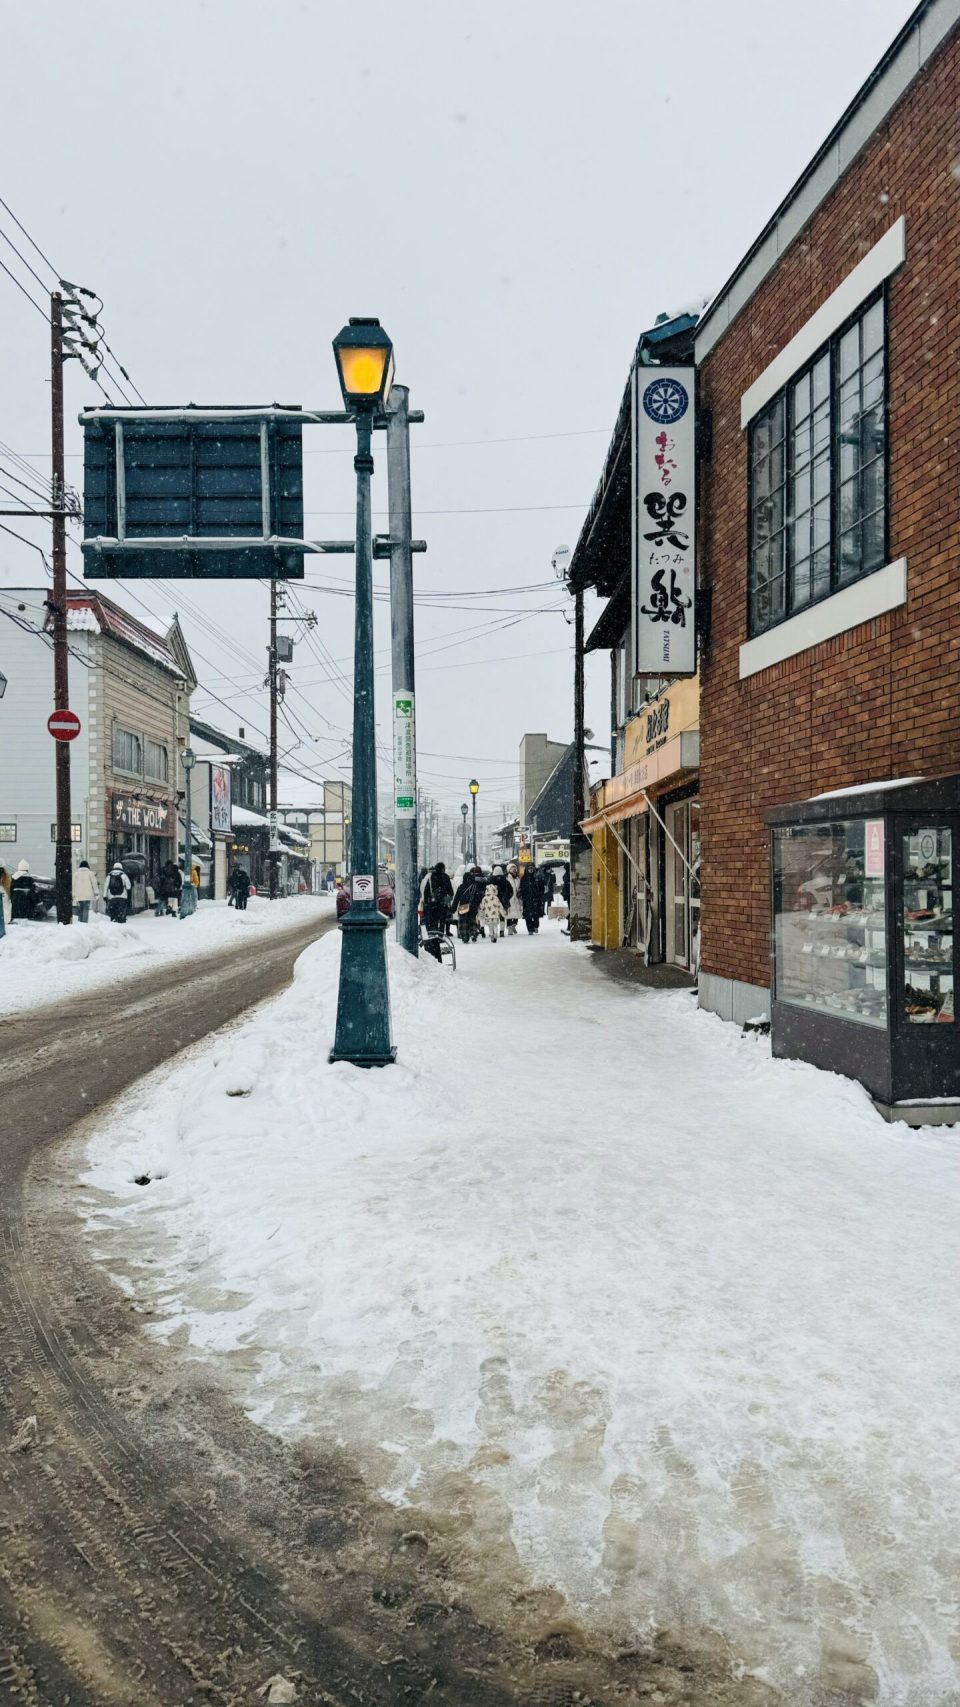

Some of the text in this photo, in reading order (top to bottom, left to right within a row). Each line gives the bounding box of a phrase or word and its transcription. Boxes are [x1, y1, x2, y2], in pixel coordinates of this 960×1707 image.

[655, 431, 677, 486] おたる
[649, 552, 685, 566] たつみ
[127, 807, 141, 826] THE
